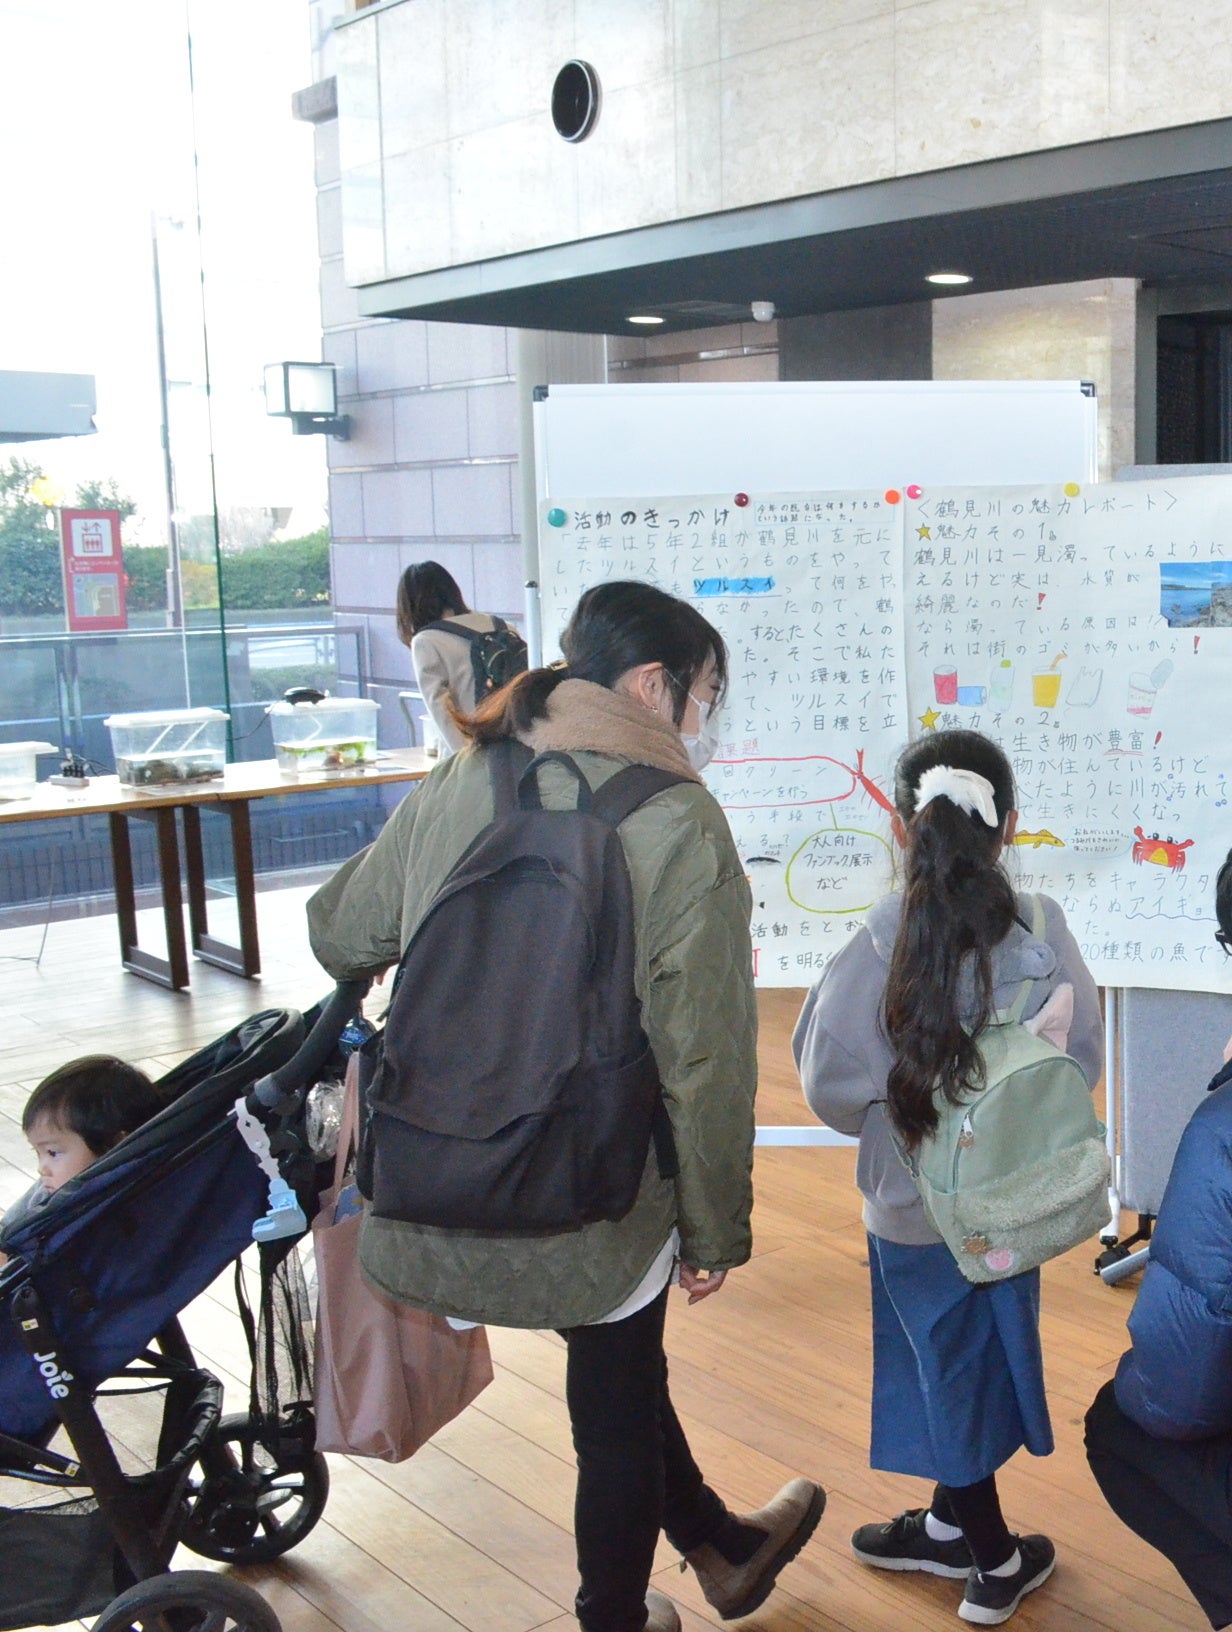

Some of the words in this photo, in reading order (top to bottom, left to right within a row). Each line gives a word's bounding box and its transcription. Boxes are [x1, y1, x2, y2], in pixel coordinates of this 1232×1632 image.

[574, 509, 731, 530] 活動のきっかけ
[811, 834, 857, 850] 大人向け
[816, 877, 849, 891] など
[33, 1351, 75, 1400] Joie
